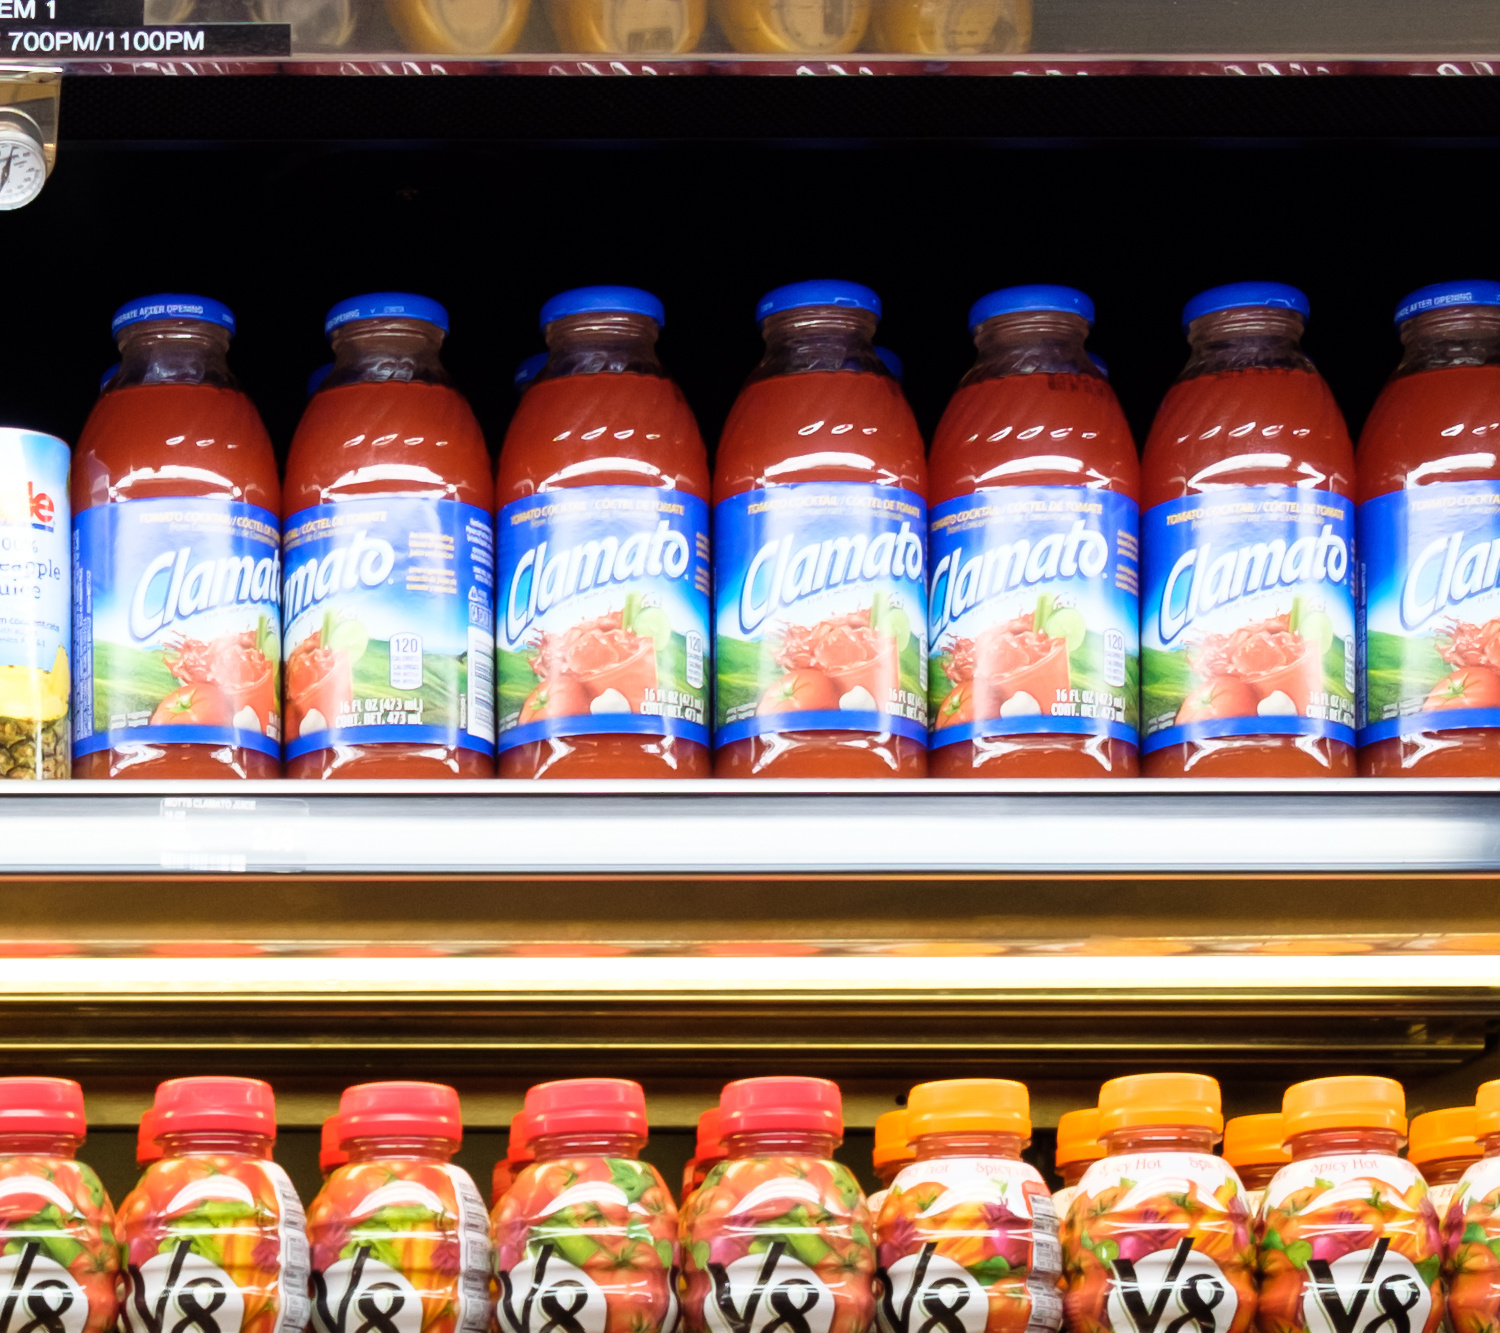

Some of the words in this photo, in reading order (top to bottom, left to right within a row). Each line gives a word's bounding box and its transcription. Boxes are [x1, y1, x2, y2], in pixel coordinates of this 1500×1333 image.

[46, 0, 56, 19] 1
[8, 30, 206, 54] 700PM/1100PM
[1159, 524, 1347, 646] Clamato
